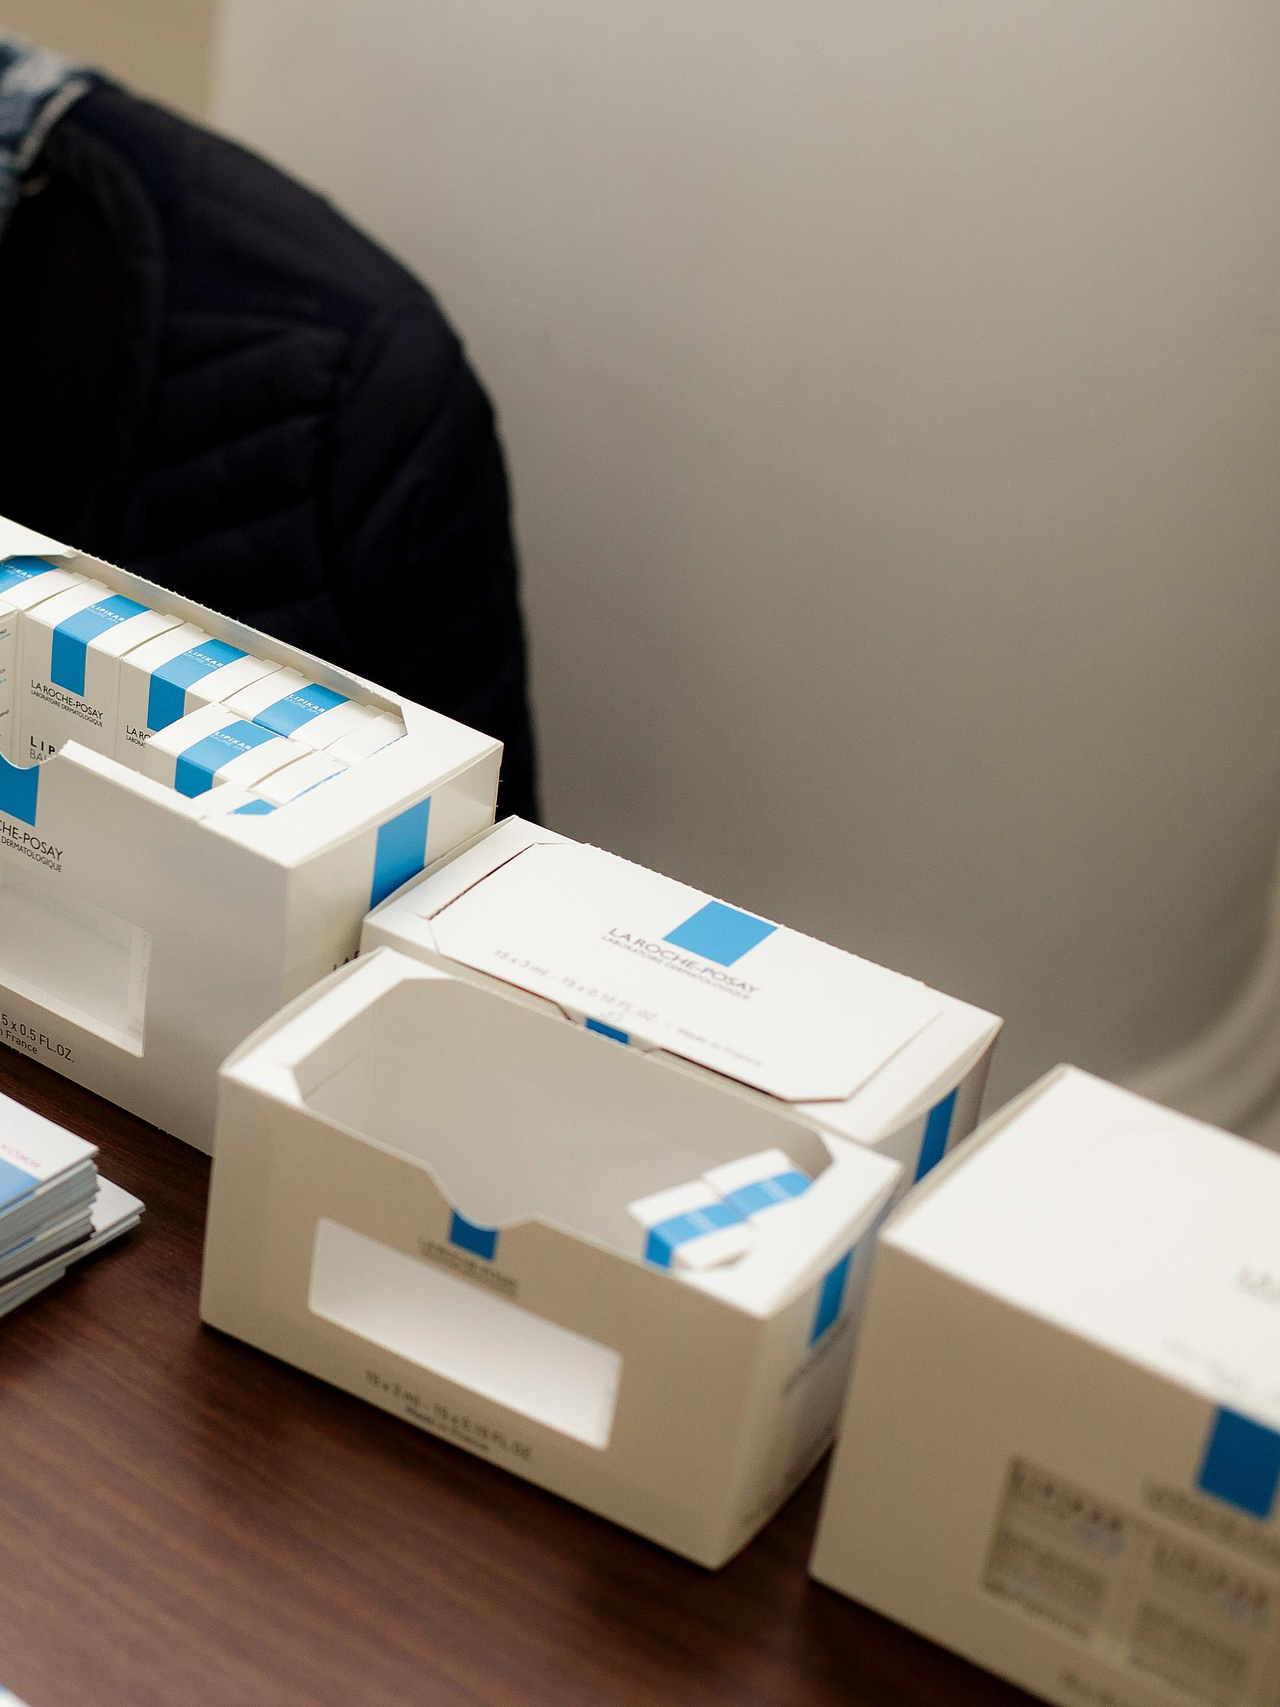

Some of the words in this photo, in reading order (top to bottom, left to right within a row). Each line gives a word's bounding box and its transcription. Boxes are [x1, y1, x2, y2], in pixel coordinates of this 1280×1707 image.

[90, 603, 126, 622] LIPIKAR
[188, 649, 224, 668] LIPIKAR
[30, 679, 43, 692] LA
[43, 685, 104, 720] ROCHE-POSAY
[288, 694, 326, 713] LIPIKAR
[126, 724, 138, 738] LA
[138, 730, 151, 741] RO
[214, 731, 252, 750] LIPIKAR
[30, 736, 56, 755] LIP
[1, 835, 63, 873] DERMATOLOGIQUE
[607, 927, 632, 943] LA
[632, 937, 762, 994] ROCHE-POSAY
[5, 1030, 39, 1055] France
[11, 1021, 17, 1032] x
[20, 1023, 36, 1041] 0.5
[39, 1034, 76, 1064] FL.OZ.
